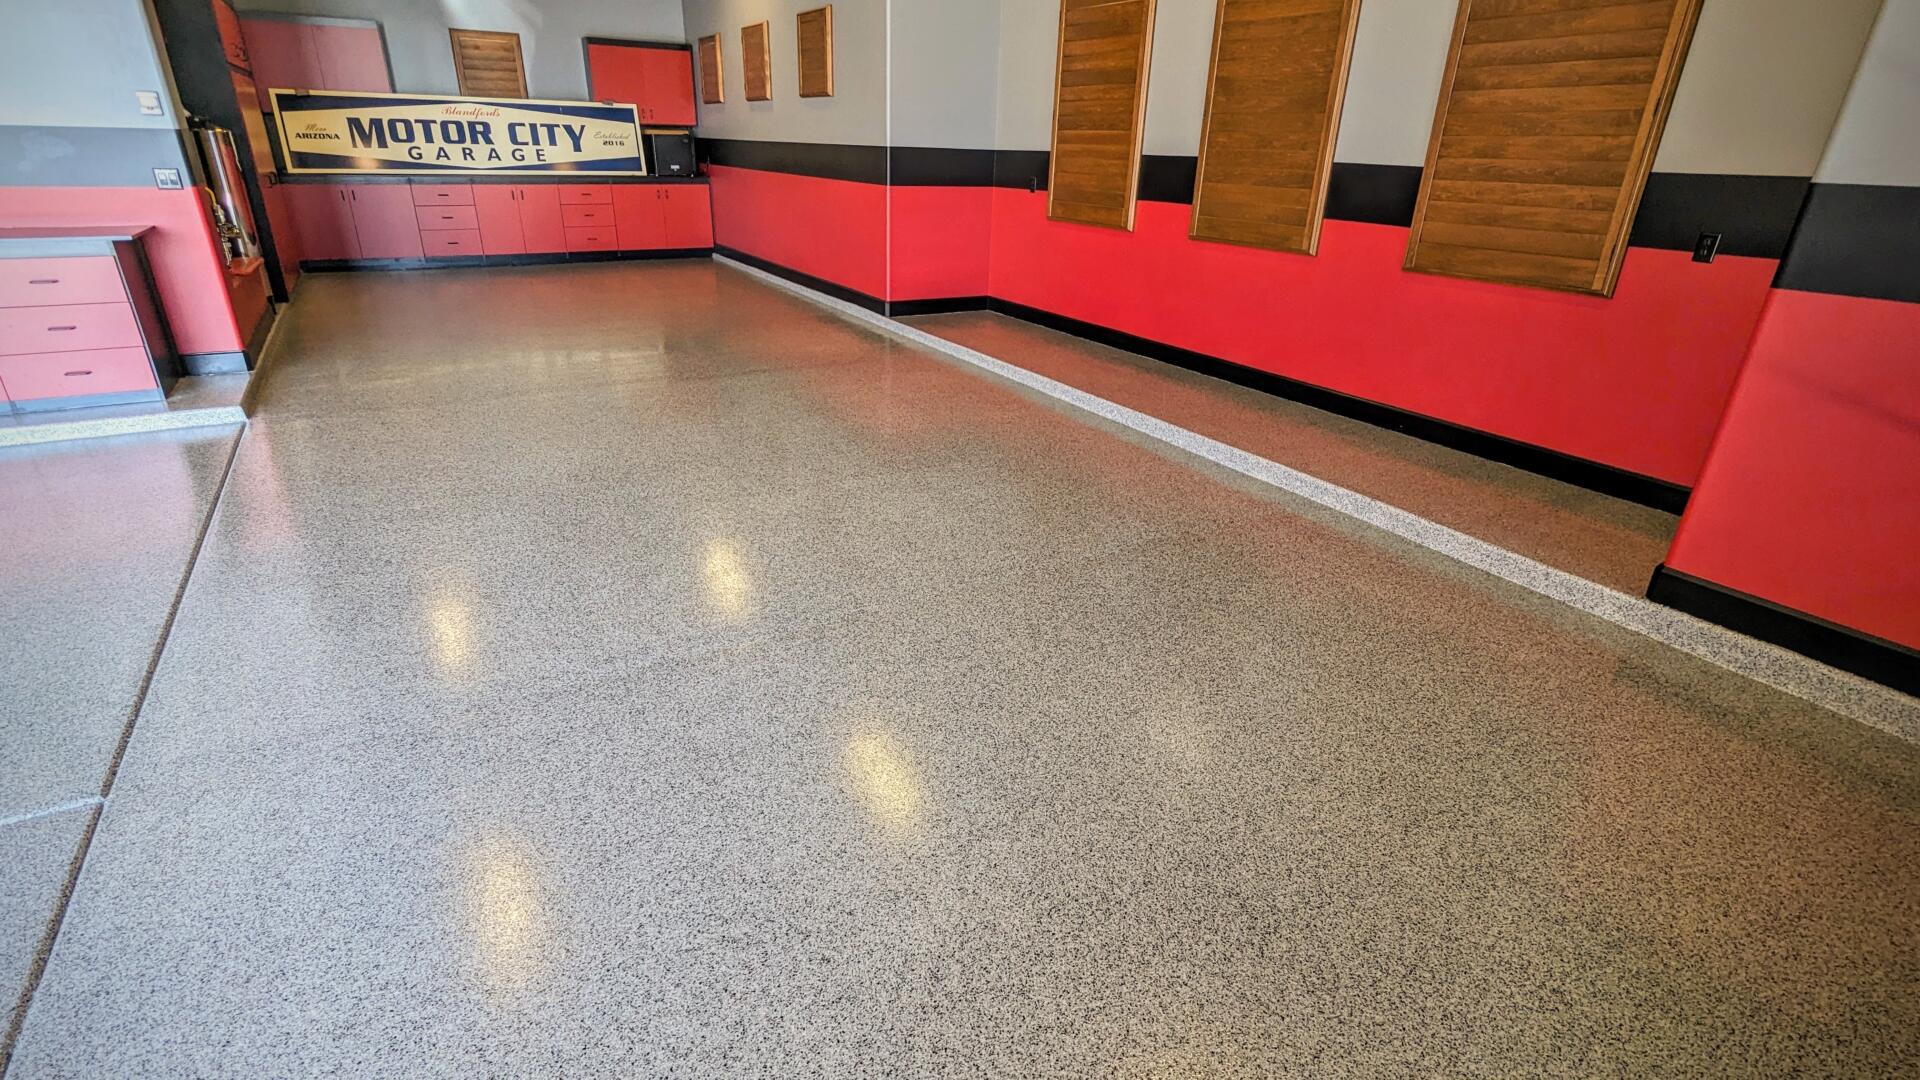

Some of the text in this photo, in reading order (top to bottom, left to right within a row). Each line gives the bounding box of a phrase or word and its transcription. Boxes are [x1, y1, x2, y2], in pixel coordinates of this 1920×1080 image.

[294, 132, 341, 140] ARIZONA
[346, 117, 586, 153] MOTOR CITY
[407, 146, 547, 162] GARAGE
